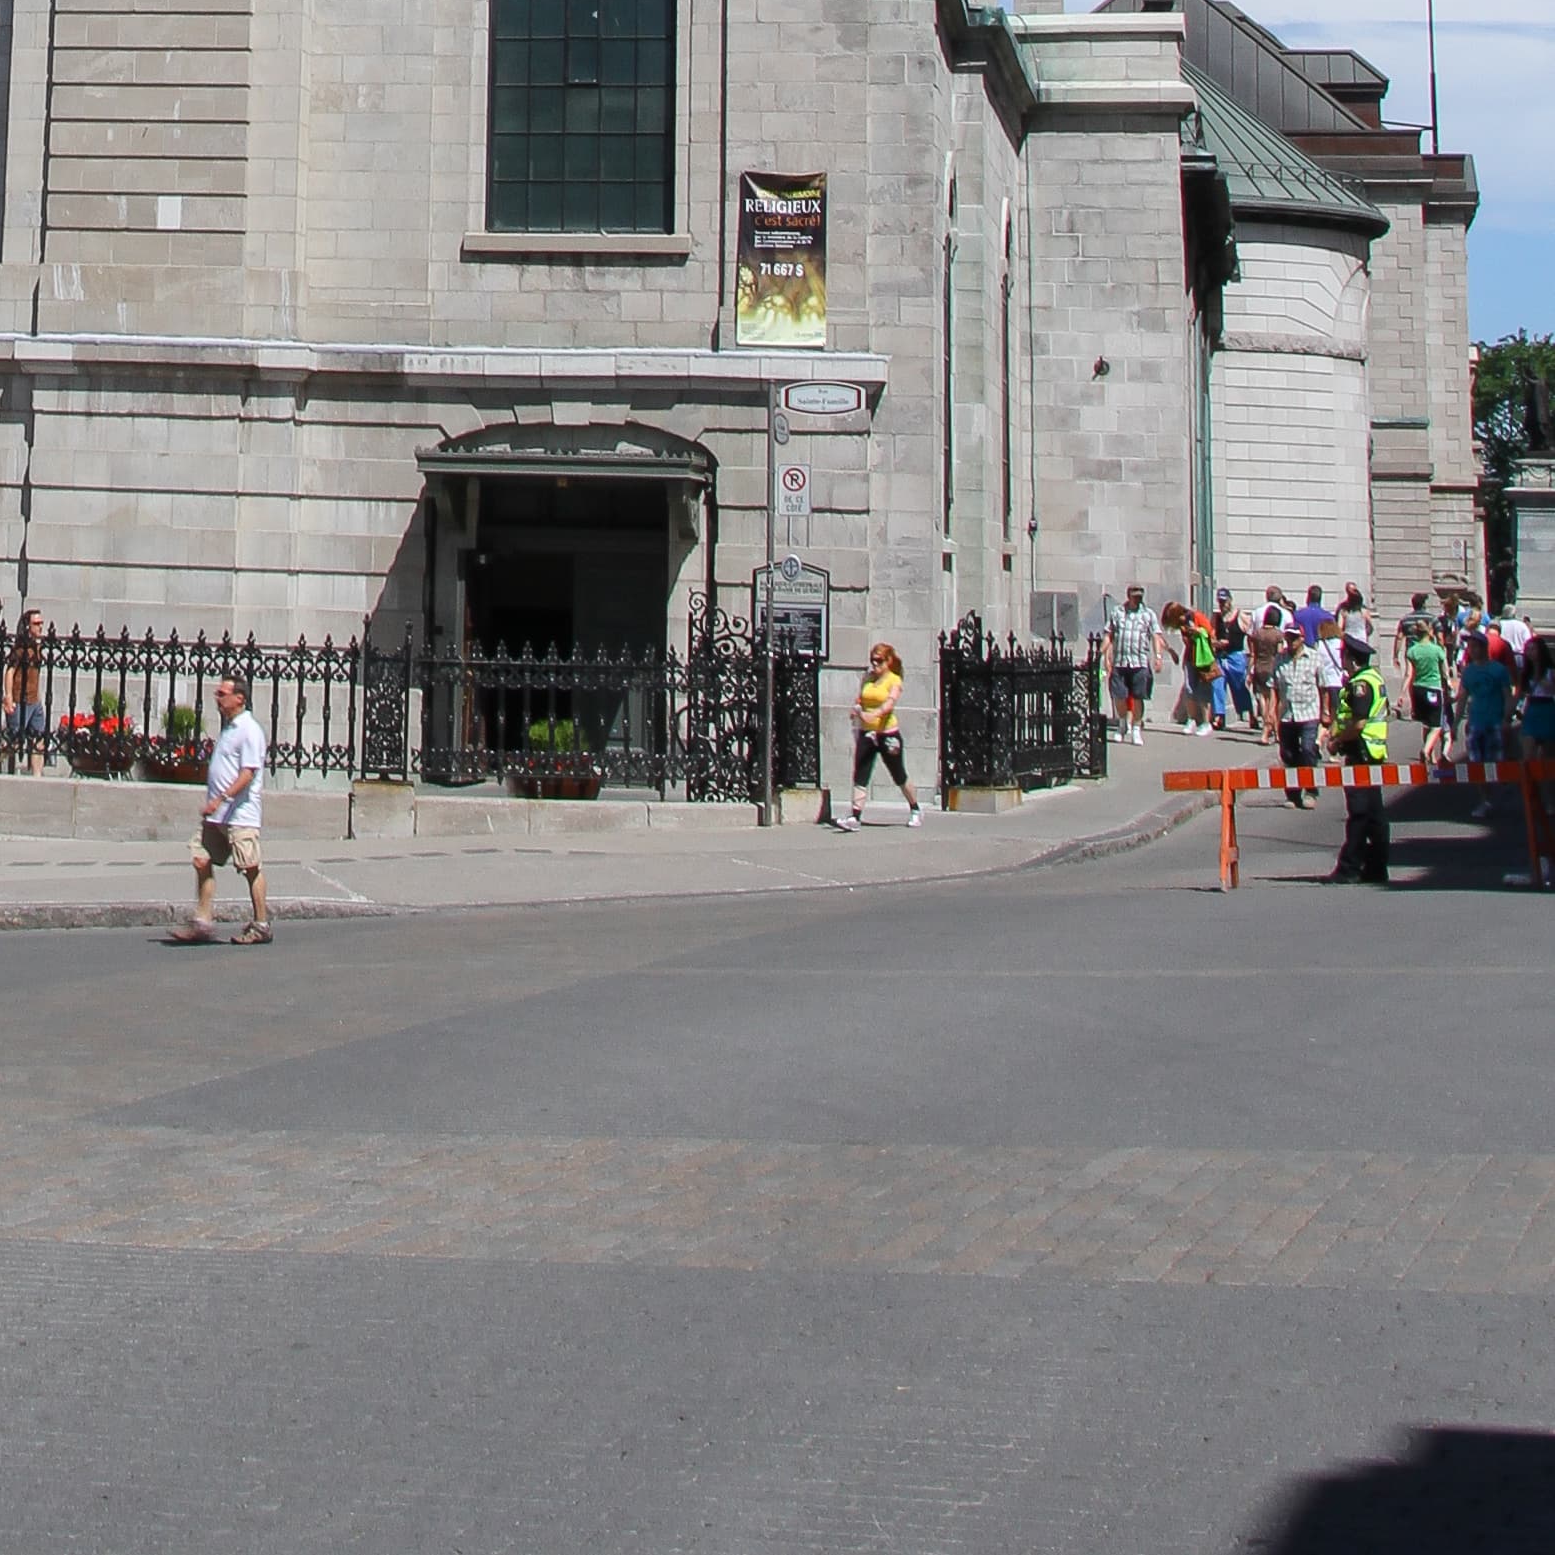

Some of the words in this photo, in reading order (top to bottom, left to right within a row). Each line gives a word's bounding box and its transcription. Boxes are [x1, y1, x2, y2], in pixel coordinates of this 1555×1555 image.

[745, 199, 821, 214] RELIGIEUX
[755, 215, 782, 226] c'est
[773, 263, 793, 277] 667
